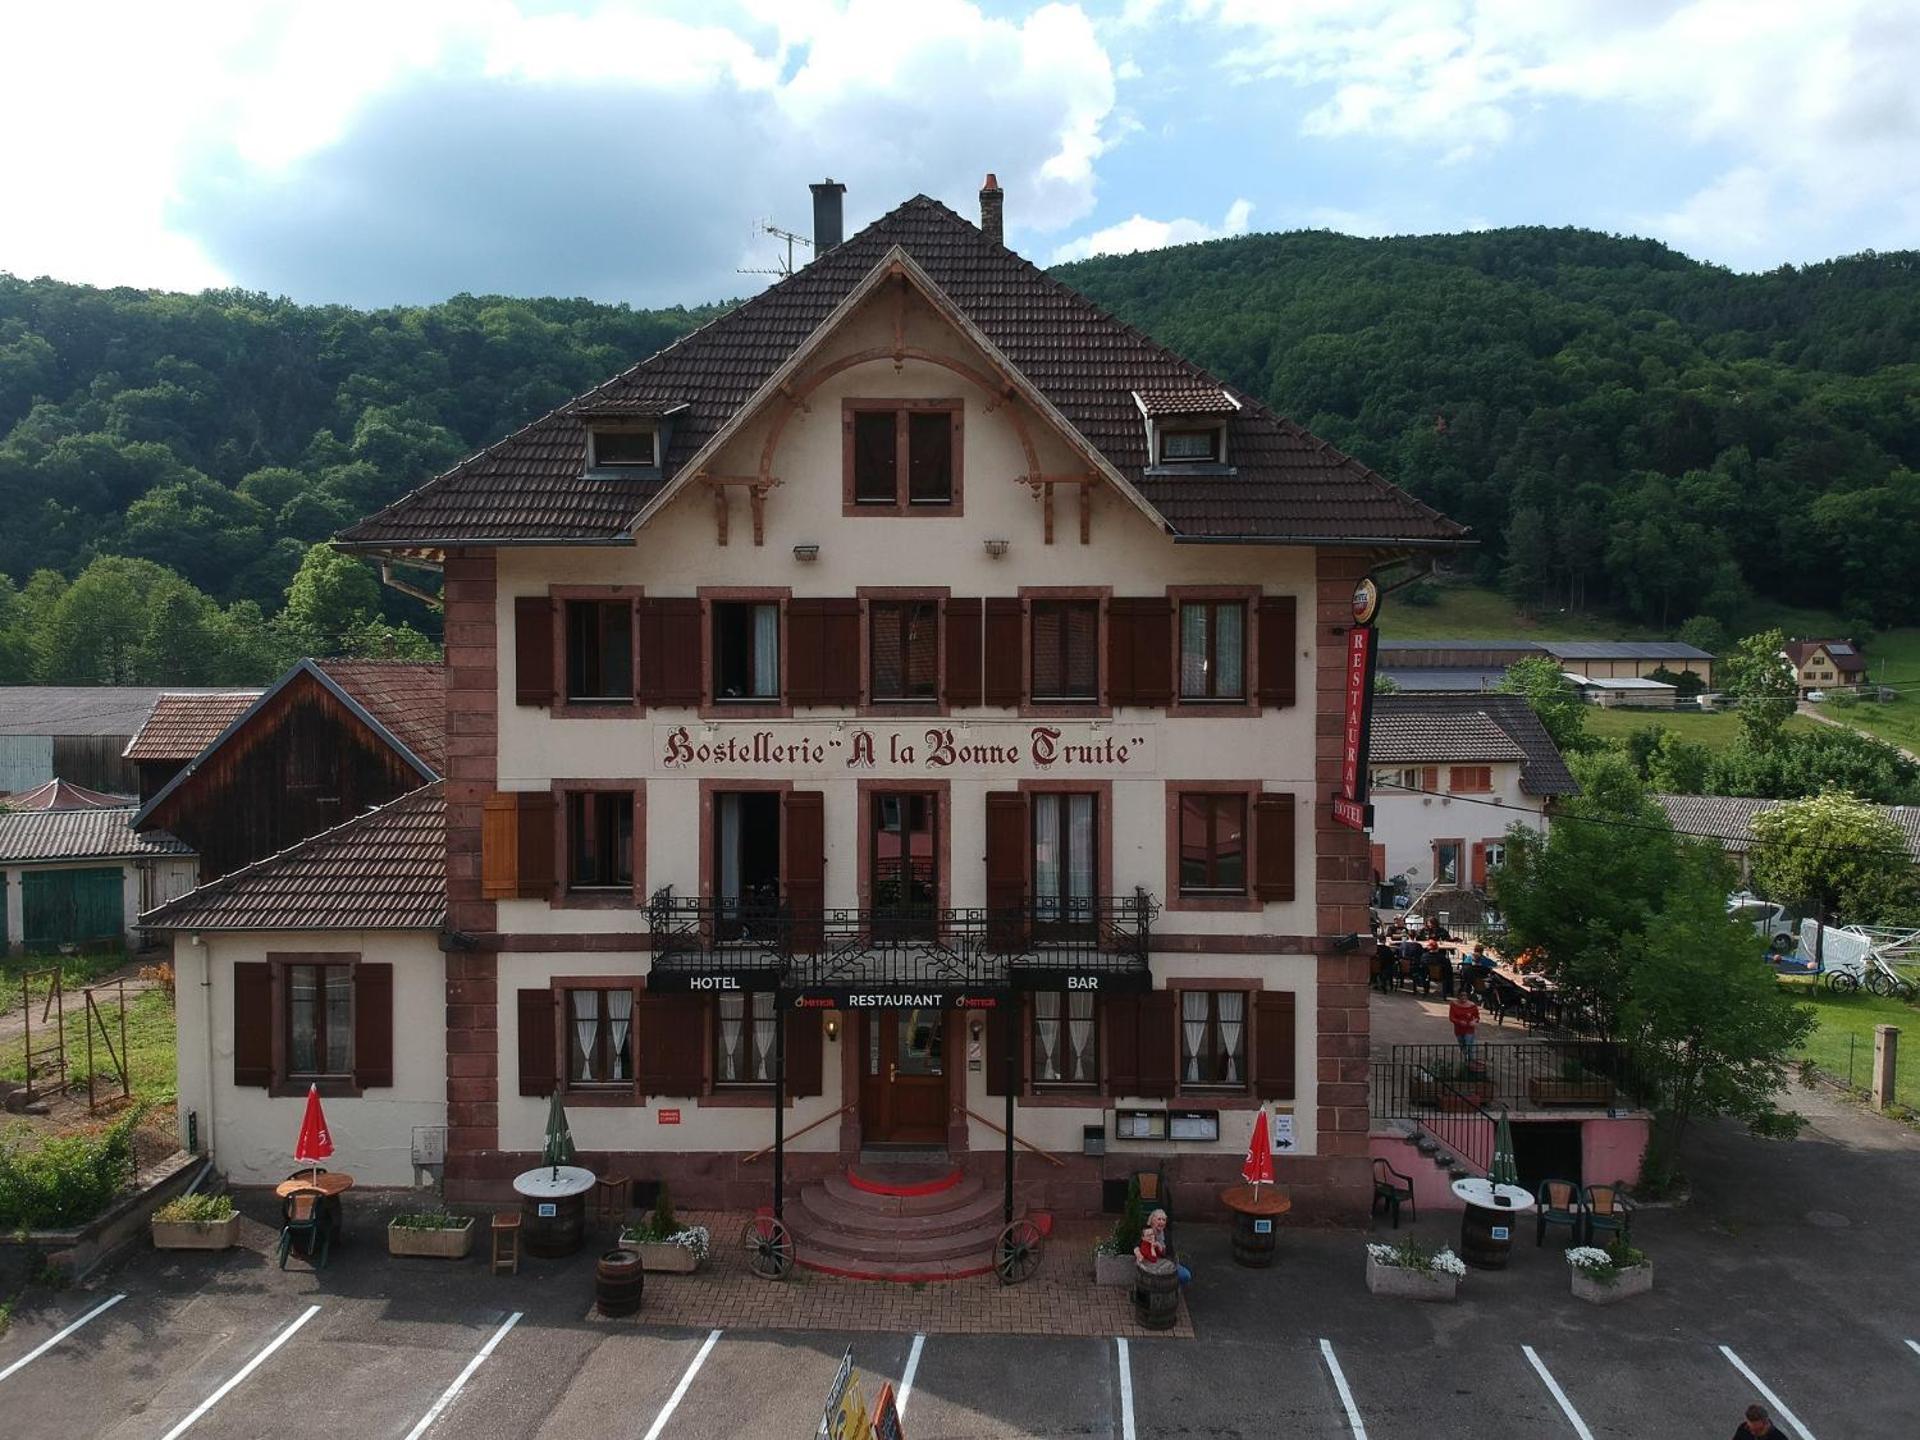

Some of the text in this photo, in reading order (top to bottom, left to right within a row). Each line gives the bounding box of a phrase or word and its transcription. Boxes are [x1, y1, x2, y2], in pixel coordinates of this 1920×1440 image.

[1344, 633, 1364, 800] RESTAURAN
[664, 726, 825, 769] Hostellerie
[889, 733, 915, 764] la
[924, 727, 1020, 769] Bonne
[690, 977, 740, 989] HOTEL
[1068, 977, 1098, 989] BAR
[849, 994, 943, 1006] RESTAURANT
